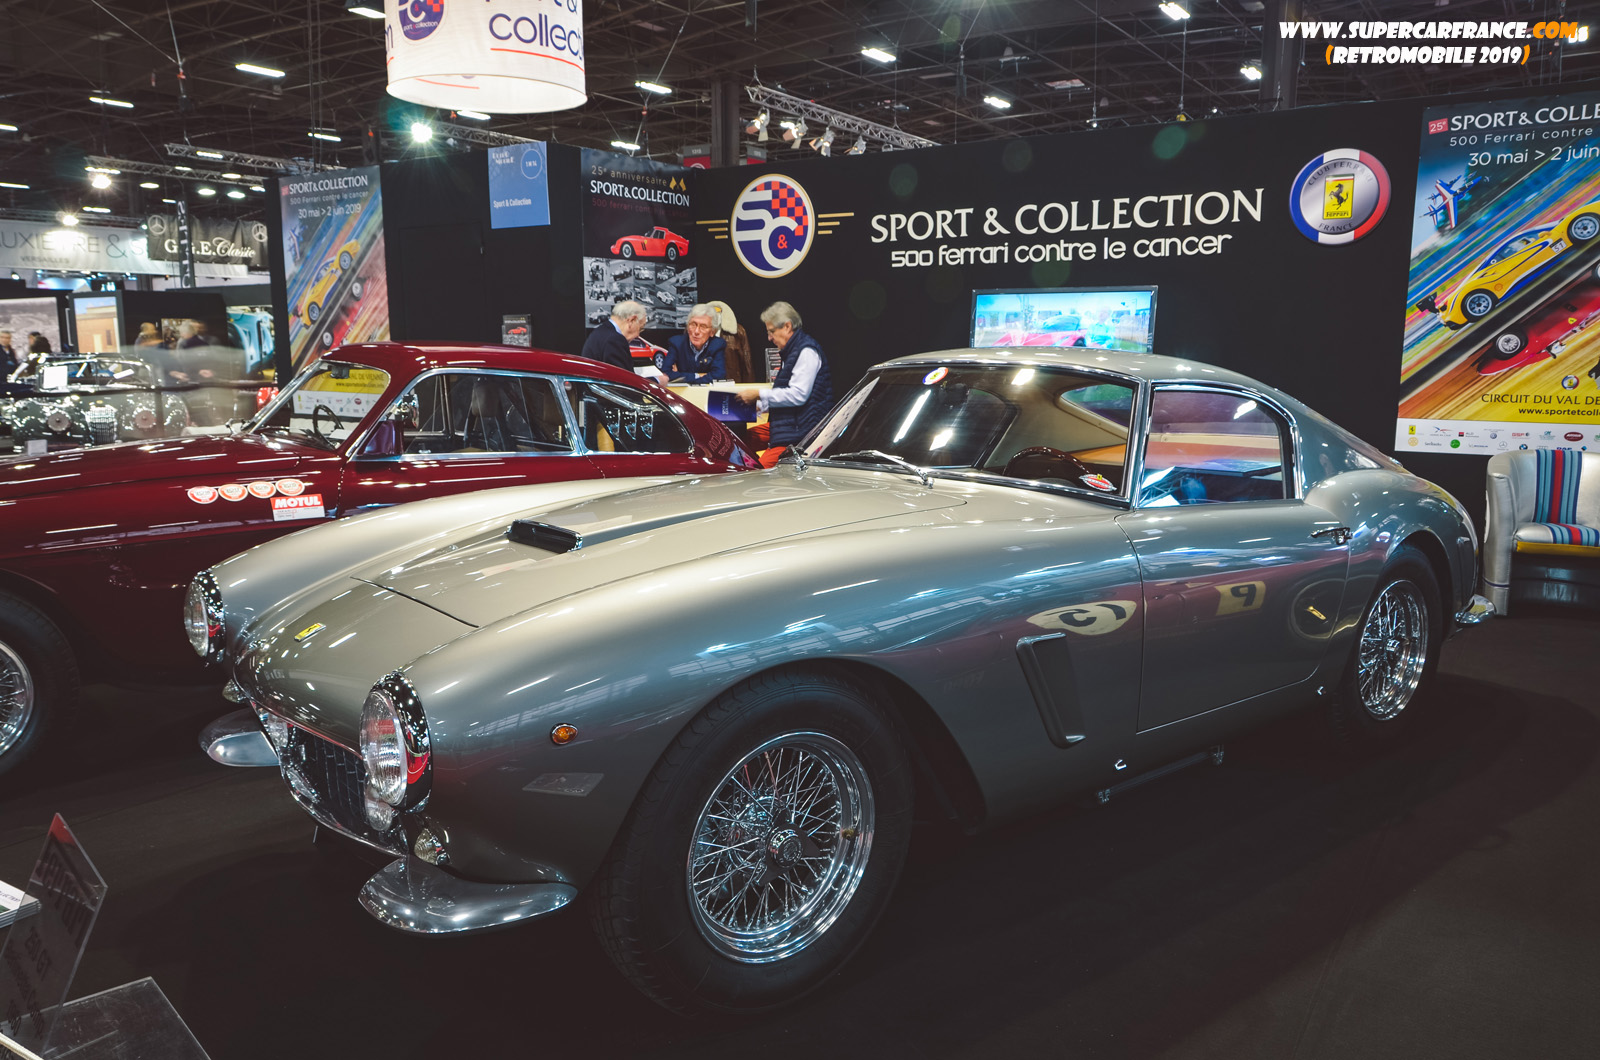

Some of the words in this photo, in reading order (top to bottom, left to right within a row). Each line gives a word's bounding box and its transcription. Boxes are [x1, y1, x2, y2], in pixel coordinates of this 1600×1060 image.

[1450, 135, 1478, 147] 500
[1484, 130, 1535, 144] Ferrari
[1542, 127, 1593, 140] contre
[1468, 152, 1491, 167] 30
[1496, 149, 1529, 165] mai
[1551, 146, 1562, 161] 2
[1565, 144, 1600, 162] juin
[610, 169, 667, 187] anniversaire
[1308, 165, 1330, 186] CLUB
[302, 195, 321, 204] Ferrari
[322, 193, 341, 202] contre
[349, 190, 369, 198] cancer
[493, 200, 505, 208] Sport
[510, 198, 532, 206] Collection
[298, 208, 307, 219] 30
[308, 208, 320, 217] mai
[345, 203, 361, 214] 2019
[871, 207, 974, 243] SPORT
[983, 207, 1011, 236] &
[1015, 188, 1265, 235] COLLECTION
[1326, 210, 1349, 218] Ferrari
[1318, 222, 1354, 232] FRANCE
[891, 249, 933, 267] 500
[938, 242, 1009, 266] ferrari
[1014, 239, 1097, 263] contre
[1103, 237, 1127, 260] le
[1133, 233, 1233, 258] cancer
[1481, 394, 1530, 403] CIRCUIT
[1533, 395, 1552, 404] DU
[1556, 395, 1581, 405] VAL
[275, 496, 321, 509] MOTUL
